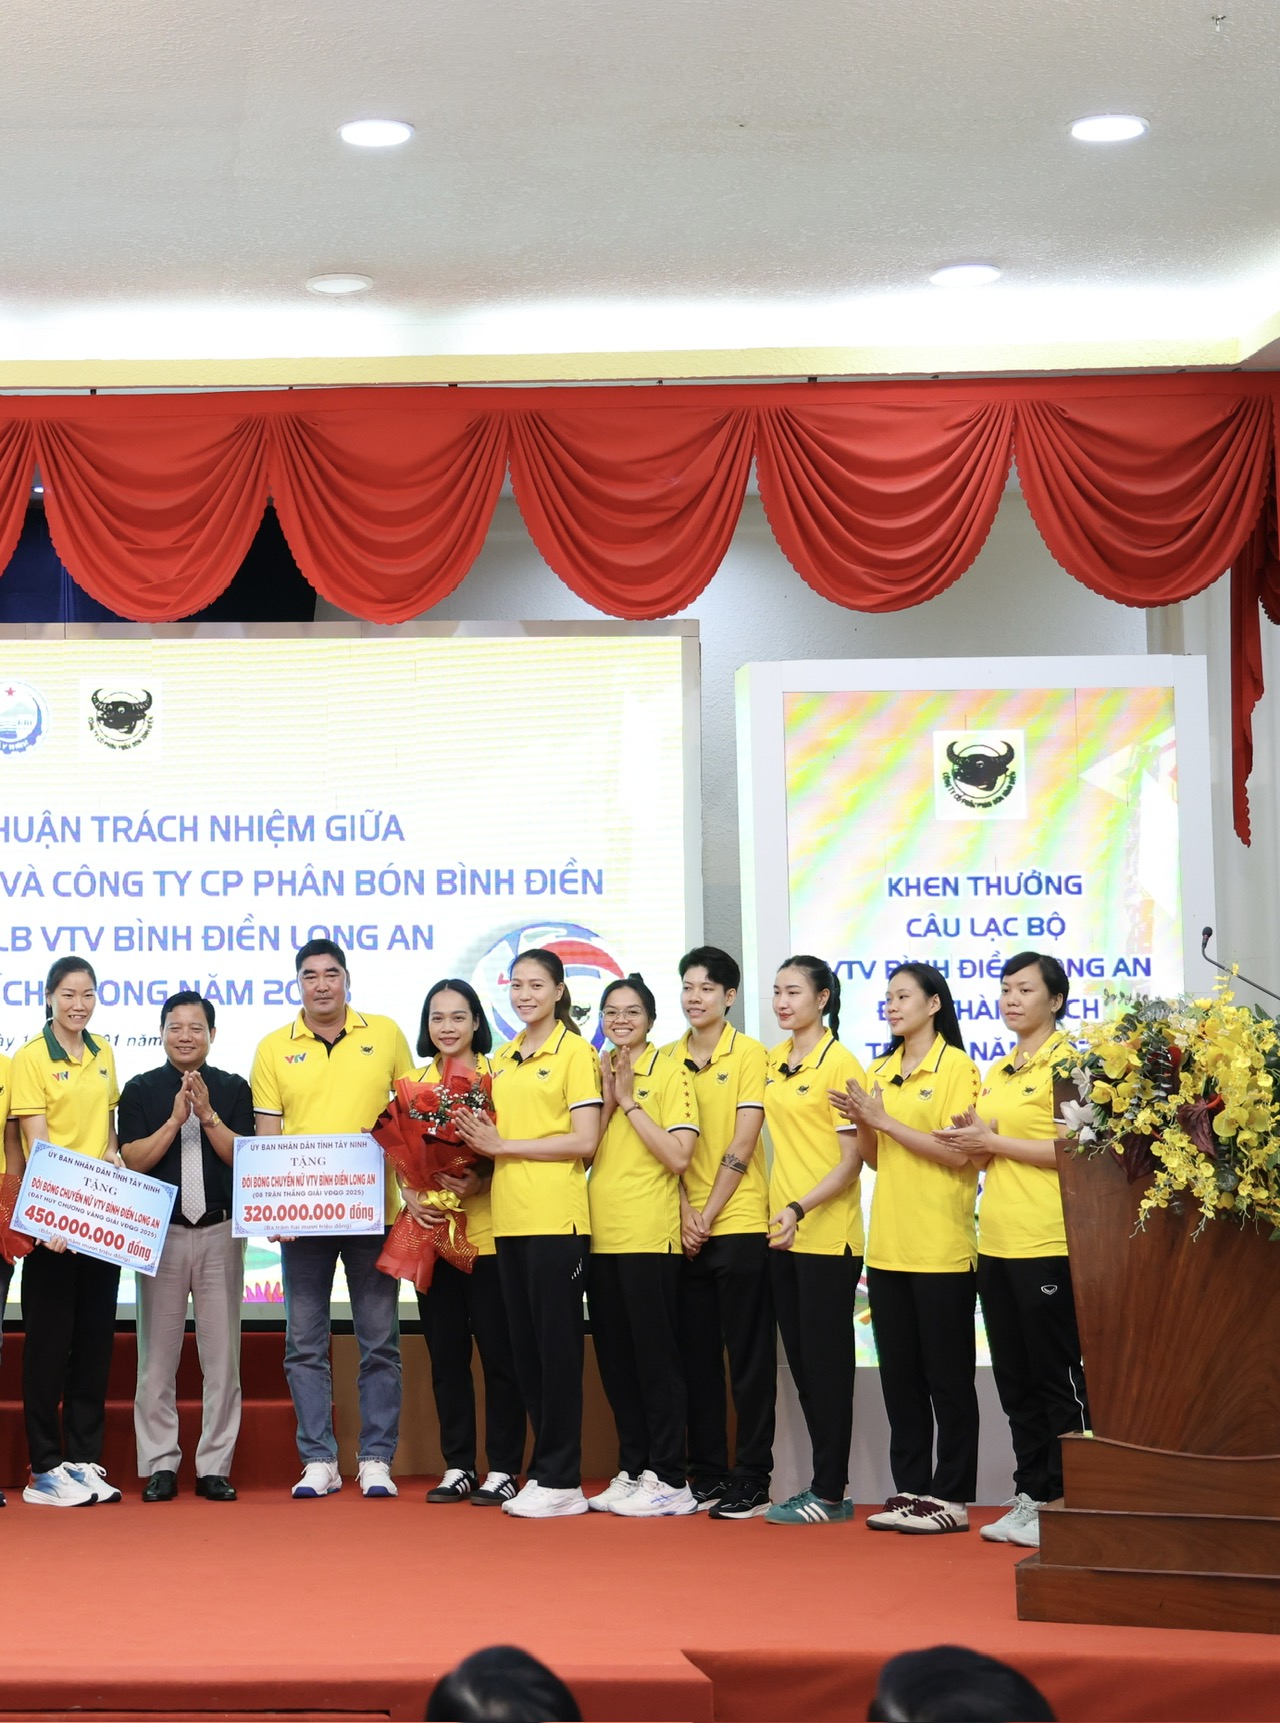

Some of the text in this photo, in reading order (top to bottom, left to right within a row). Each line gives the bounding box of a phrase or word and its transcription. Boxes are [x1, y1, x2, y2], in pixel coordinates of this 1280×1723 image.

[91, 809, 198, 842] TRÁCH
[211, 809, 314, 848] NHIỆM
[326, 810, 404, 841] GIỮA
[0, 862, 44, 897] VÀ
[53, 863, 143, 897] CÔNG
[154, 870, 191, 897] TY
[201, 870, 243, 896] CP
[254, 863, 344, 896] PHÂN
[356, 863, 424, 896] BÓN
[437, 863, 514, 896] BÌNH
[525, 857, 603, 895] ĐIỀN
[888, 869, 1082, 897] KHEN THƯỞNG
[42, 926, 104, 951] VTV
[115, 918, 191, 952] BÌNH
[203, 914, 279, 952] ĐIỀN
[290, 925, 378, 951] LONG
[387, 925, 433, 951] AN
[907, 911, 1067, 942] CÂU LẠC BỘ
[957, 950, 1004, 980] ĐIỀ
[1112, 957, 1151, 978] AN
[96, 980, 169, 1007] ONG
[284, 1052, 307, 1064] VTV
[52, 1072, 69, 1081] VTV
[261, 1143, 276, 1151] BAN
[278, 1141, 298, 1150] NHÂN
[300, 1141, 315, 1149] DÂN
[349, 1141, 368, 1149] NINH
[59, 1154, 74, 1165] BAN
[143, 1183, 161, 1194] NINH
[290, 1155, 326, 1169] TẶNG
[83, 1176, 118, 1196] TẶNG
[306, 1174, 318, 1187] VTV
[349, 1174, 366, 1186] LONG
[366, 1174, 376, 1185] AN
[346, 1189, 364, 1197] 2025)
[94, 1198, 107, 1211] VTV
[134, 1212, 151, 1227] LONG
[151, 1218, 161, 1229] AN
[243, 1202, 374, 1222] 320.000.000 đồng
[24, 1204, 152, 1262] 450.000.000 đồng
